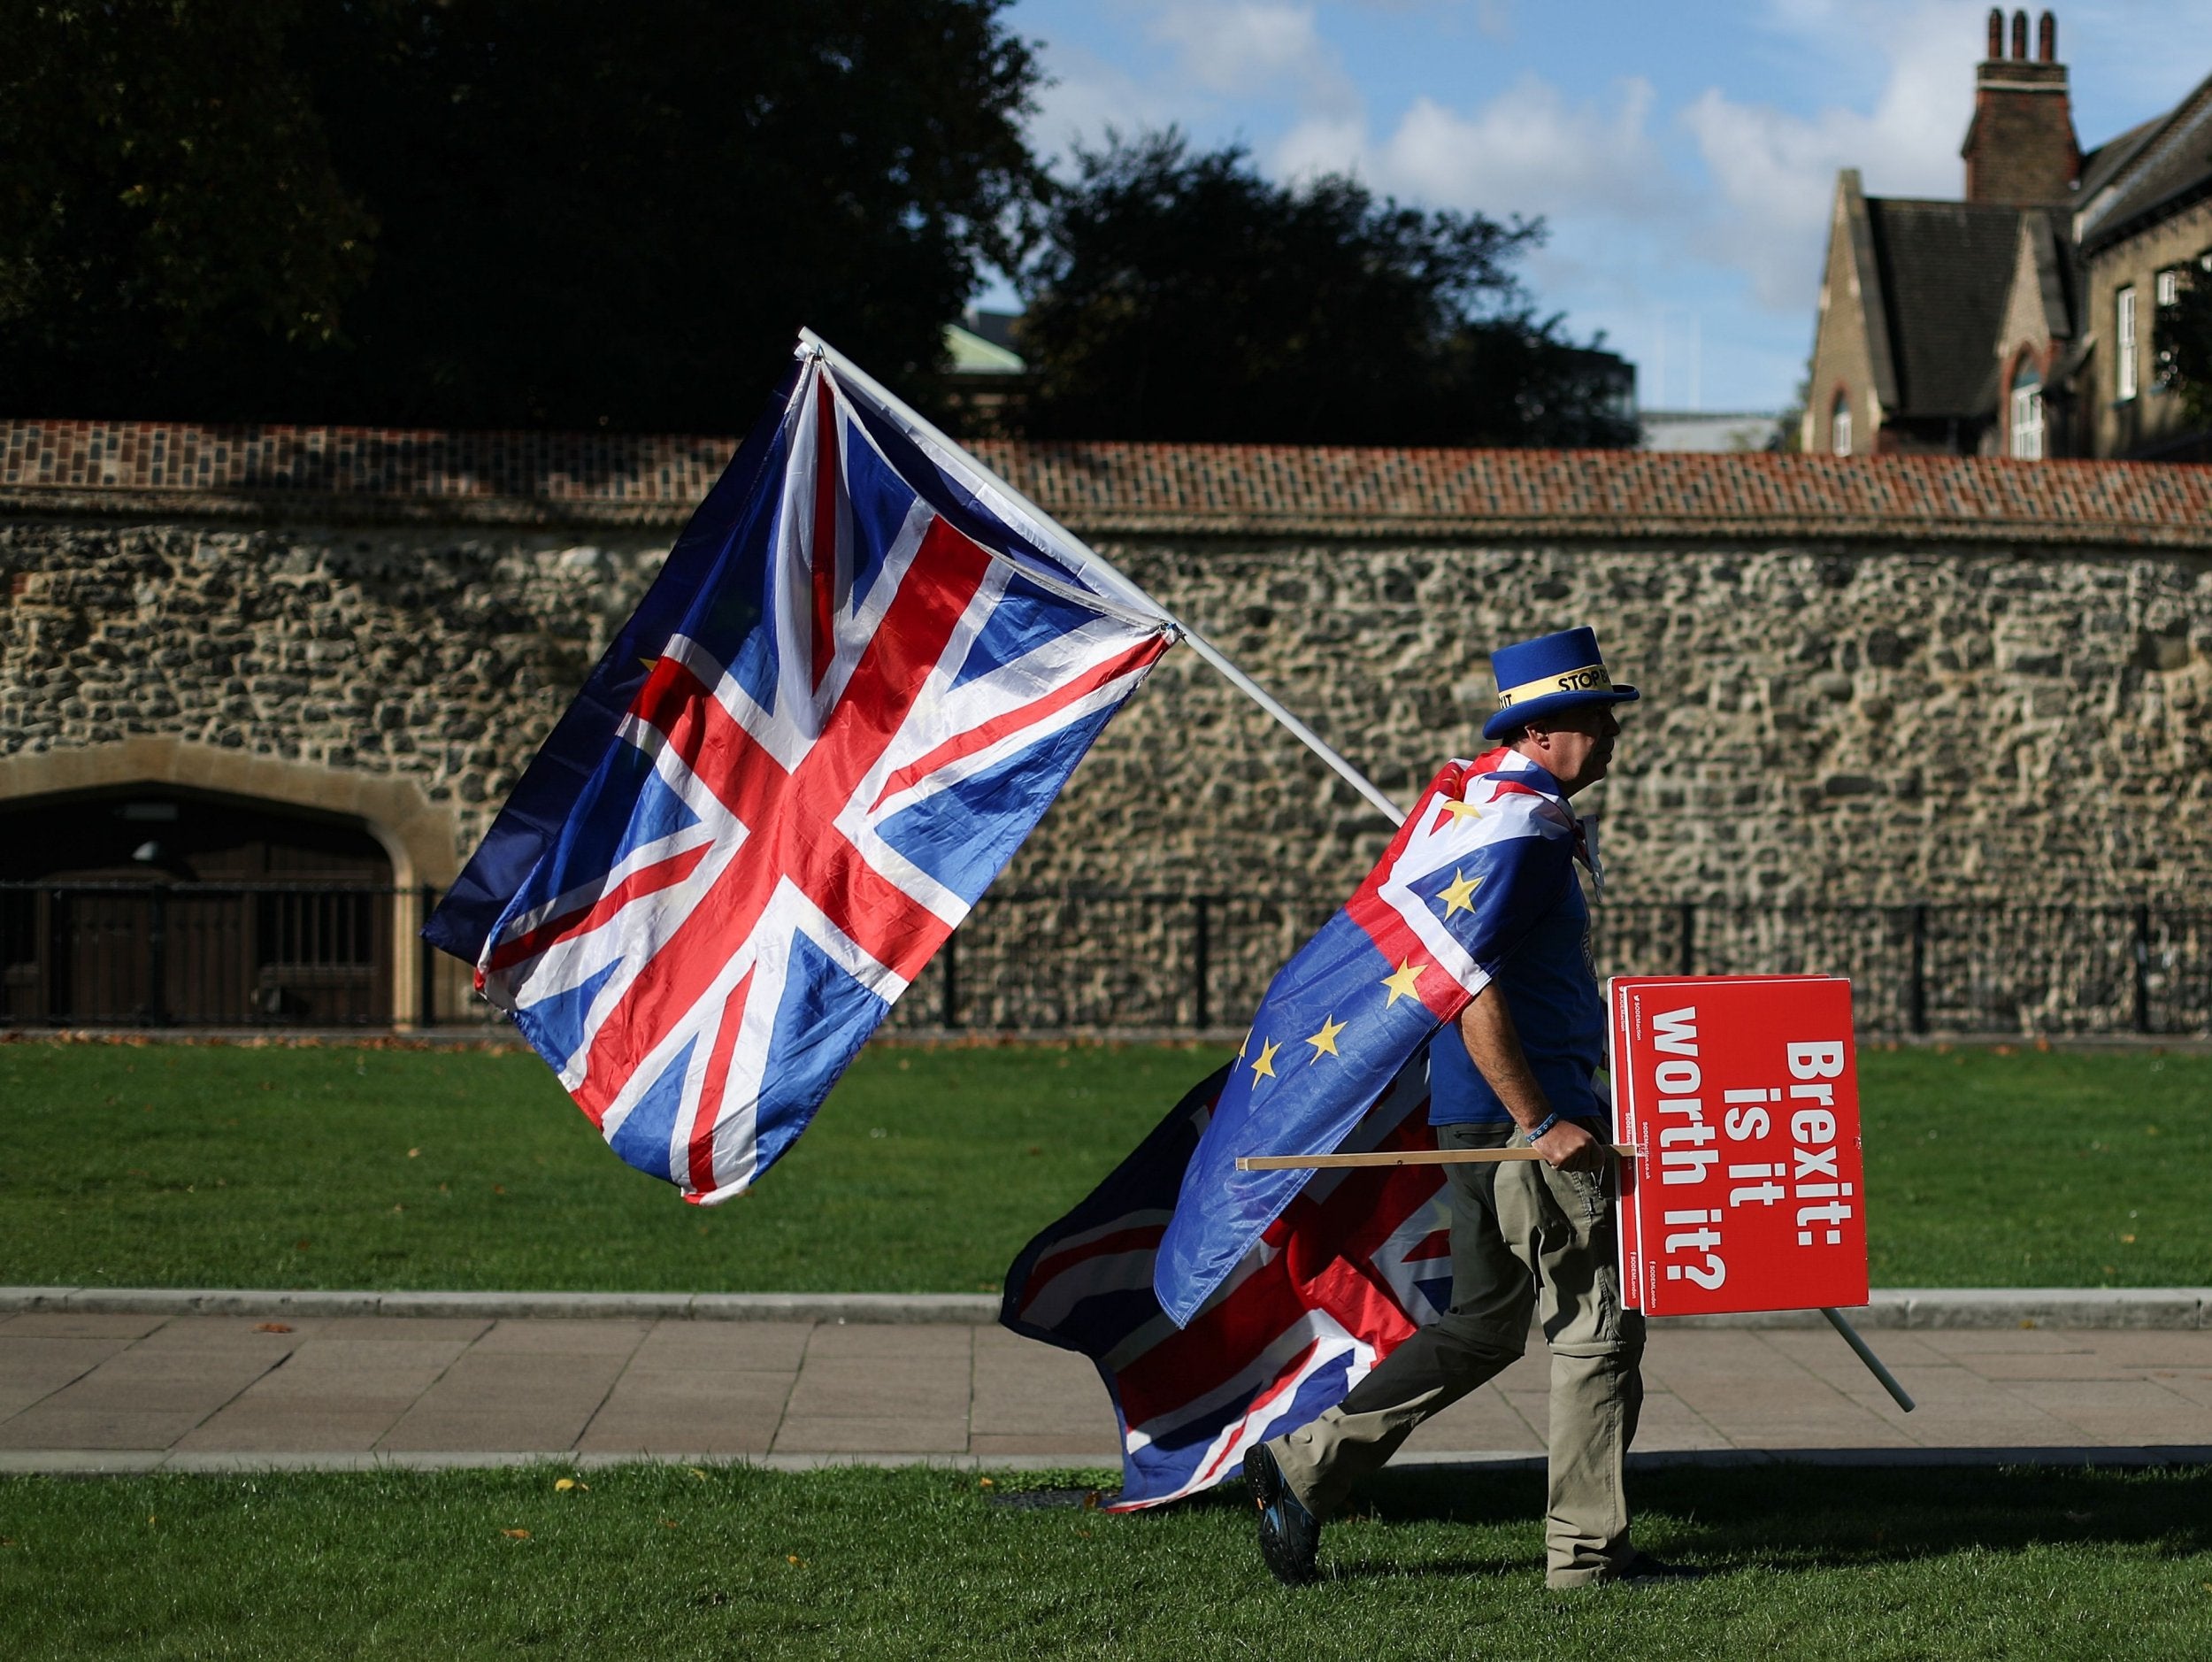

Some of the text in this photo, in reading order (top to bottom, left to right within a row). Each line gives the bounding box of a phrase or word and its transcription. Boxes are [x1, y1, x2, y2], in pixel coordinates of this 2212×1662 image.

[1499, 694, 1512, 710] XIT
[1558, 671, 1599, 692] STOP
[1652, 1006, 1726, 1291] worth it?
[1724, 1088, 1786, 1208] is it
[1786, 1041, 1853, 1246] Brexit:
